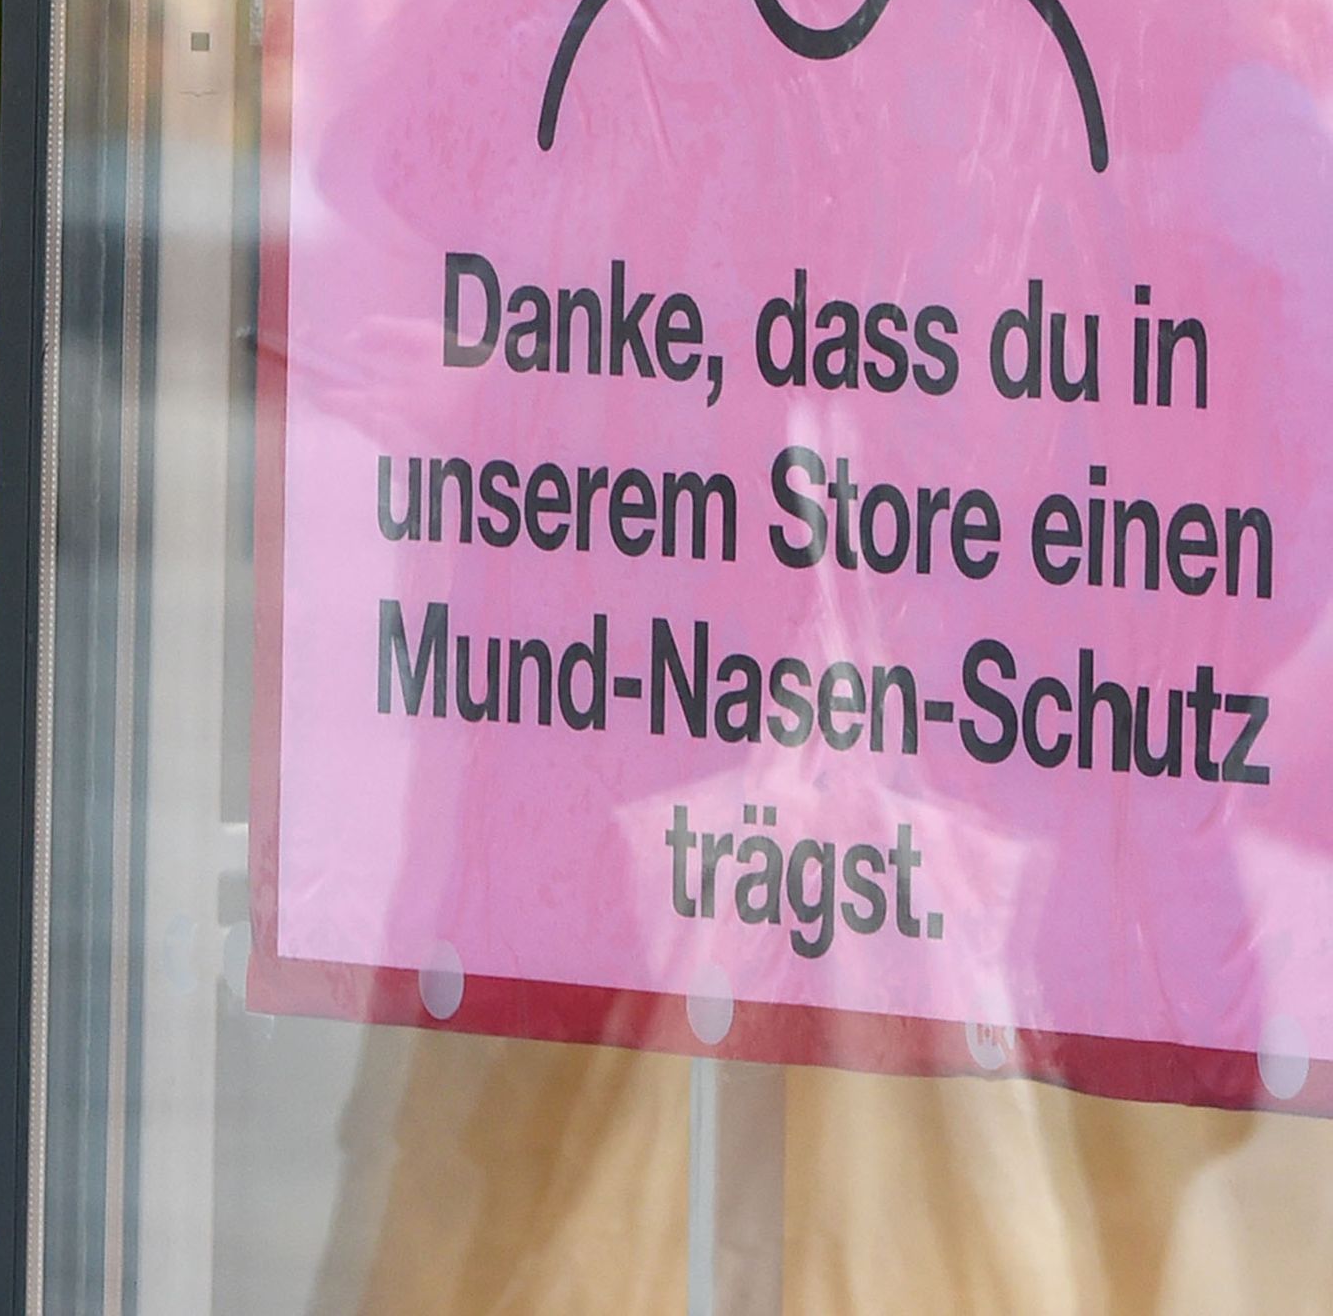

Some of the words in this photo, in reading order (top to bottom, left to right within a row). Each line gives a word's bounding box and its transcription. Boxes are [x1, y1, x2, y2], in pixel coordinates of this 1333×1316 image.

[444, 252, 723, 407] Danke,
[756, 268, 959, 396] dass
[990, 279, 1099, 403] du
[1133, 285, 1207, 409] in
[376, 456, 737, 562] unserem
[769, 448, 1001, 580] Store
[1031, 465, 1273, 599] einen
[377, 598, 1271, 786] Mund-Nasen-Schutz
[665, 804, 945, 959] trägst.
